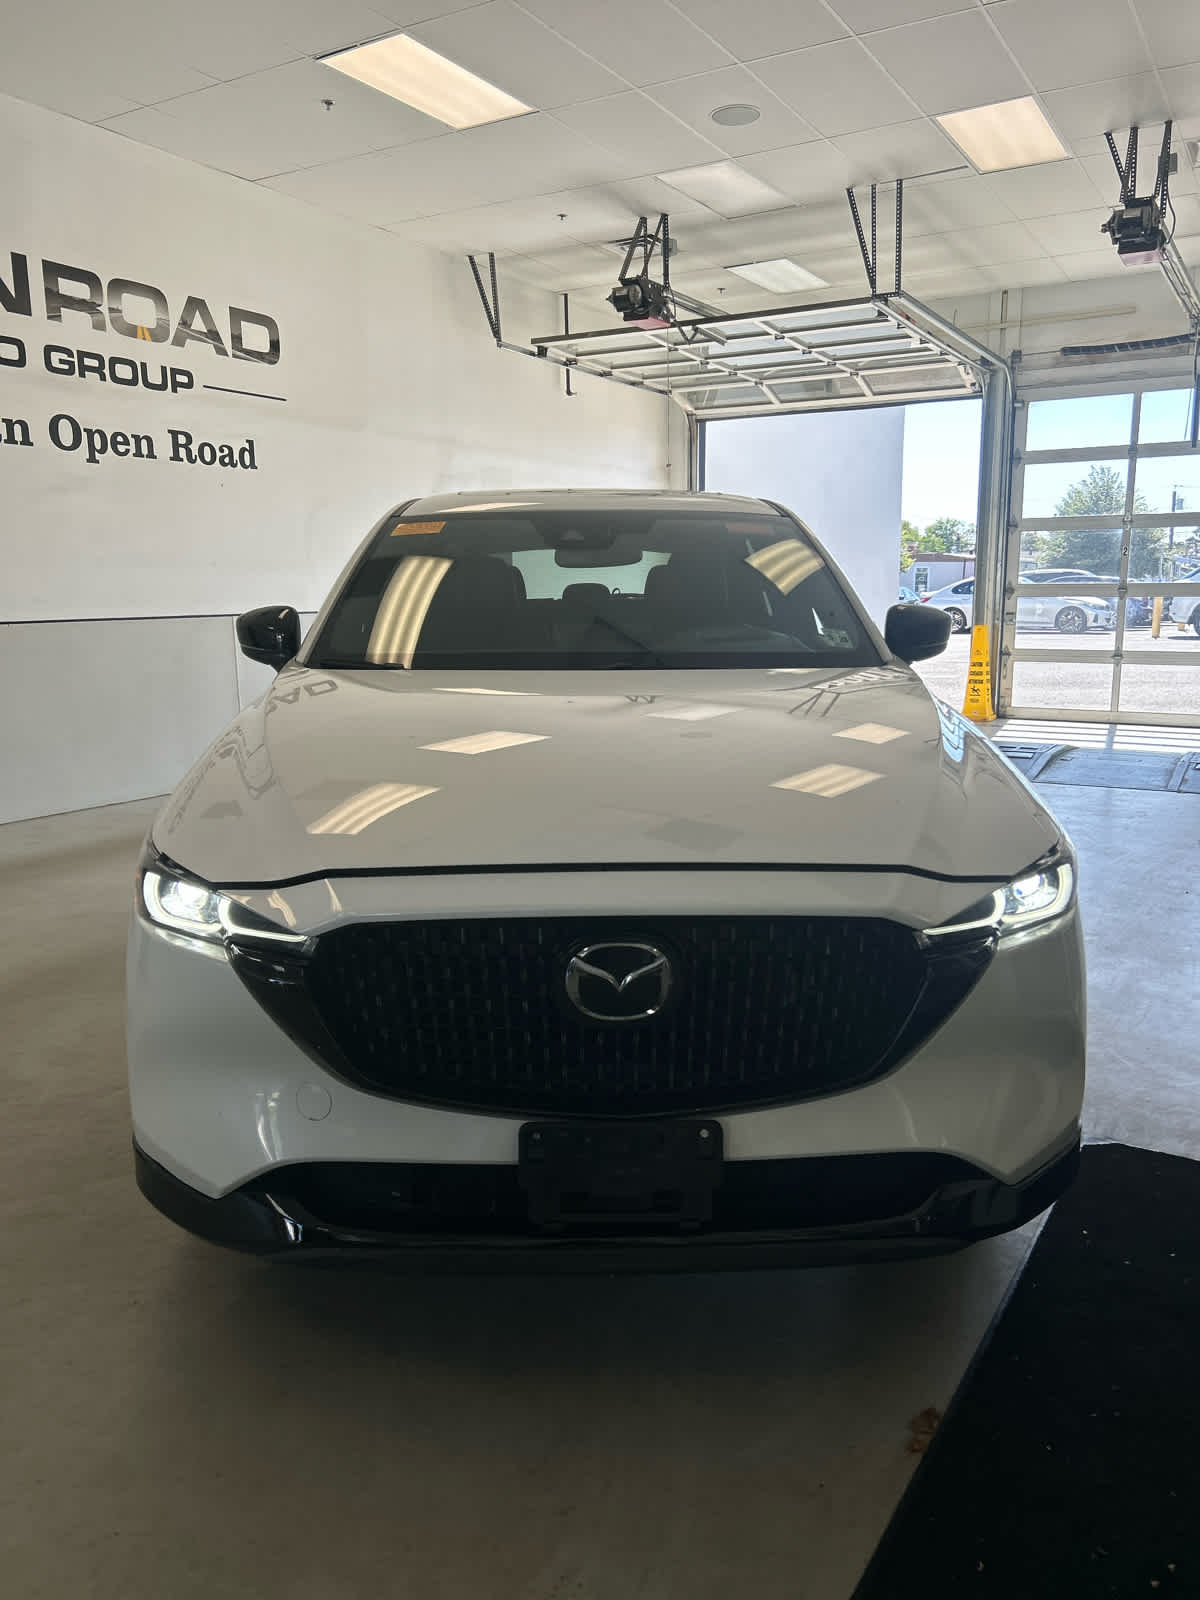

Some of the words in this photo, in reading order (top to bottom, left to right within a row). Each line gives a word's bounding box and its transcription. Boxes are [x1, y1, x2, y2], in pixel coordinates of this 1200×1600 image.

[43, 344, 194, 393] GROUP
[0, 417, 34, 446] n
[48, 413, 158, 464] Open
[167, 429, 258, 469] Road
